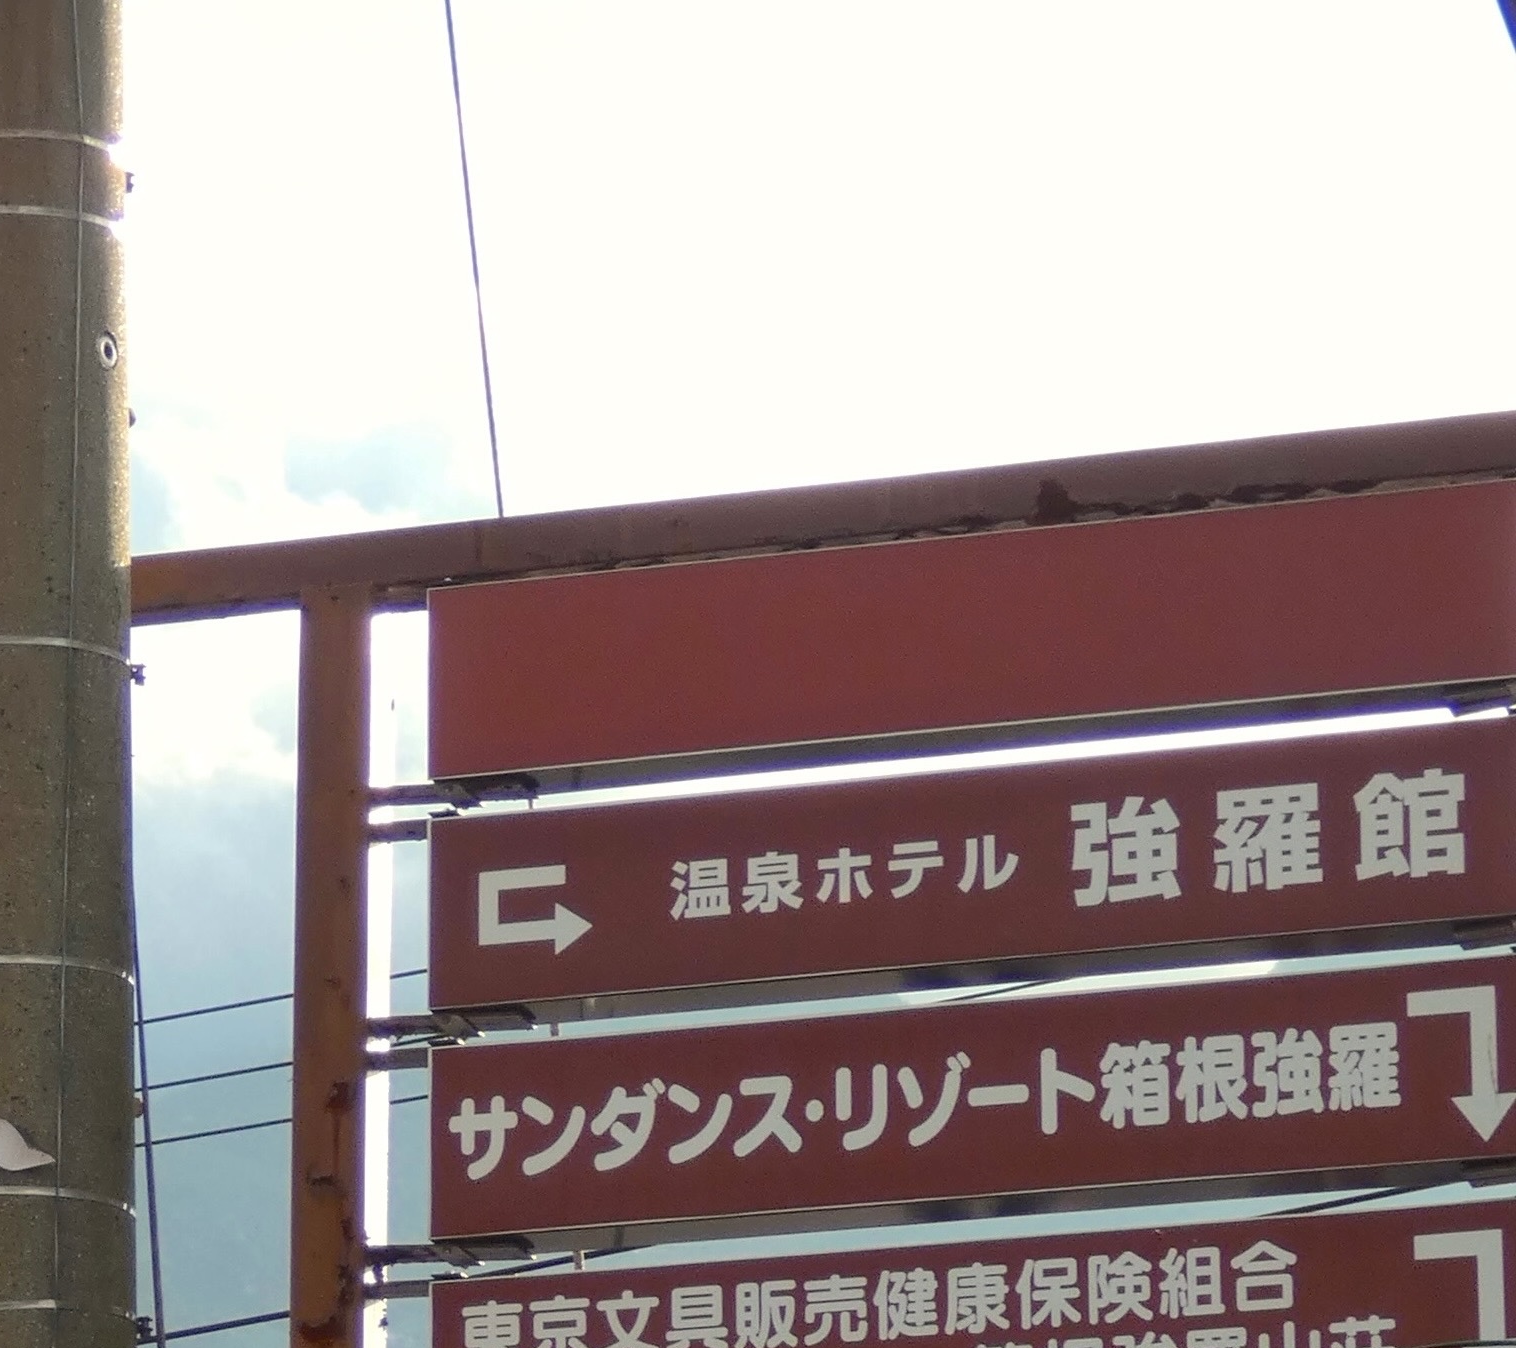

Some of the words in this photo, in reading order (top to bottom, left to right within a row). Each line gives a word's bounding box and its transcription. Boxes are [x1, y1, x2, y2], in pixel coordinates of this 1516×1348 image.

[670, 834, 1019, 920] 温泉ホテル
[1072, 767, 1467, 907] 強羅館
